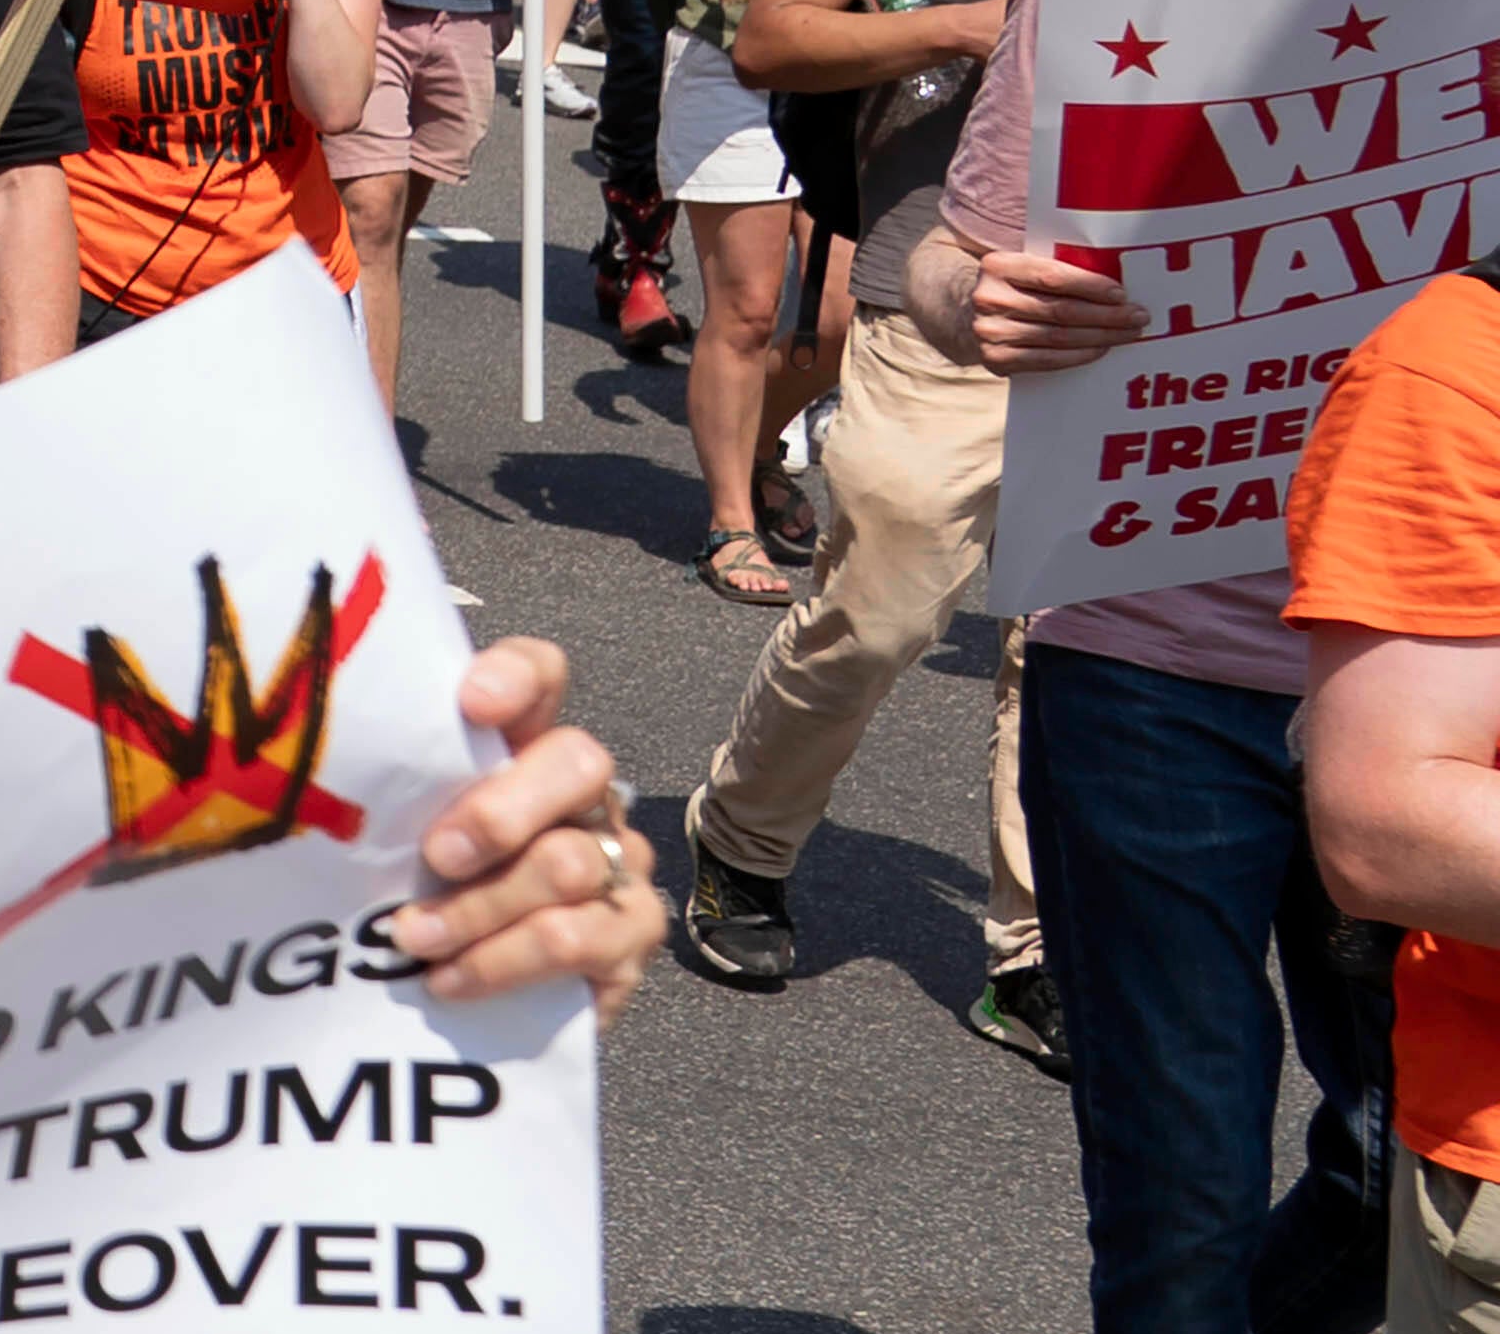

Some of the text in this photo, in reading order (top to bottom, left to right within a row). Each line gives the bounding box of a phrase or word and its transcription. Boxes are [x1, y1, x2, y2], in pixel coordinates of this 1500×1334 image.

[137, 51, 275, 108] MUST
[1203, 45, 1483, 195] WE
[1126, 345, 1350, 410] the RIG
[1099, 405, 1308, 483] FREE
[1089, 498, 1153, 547] &
